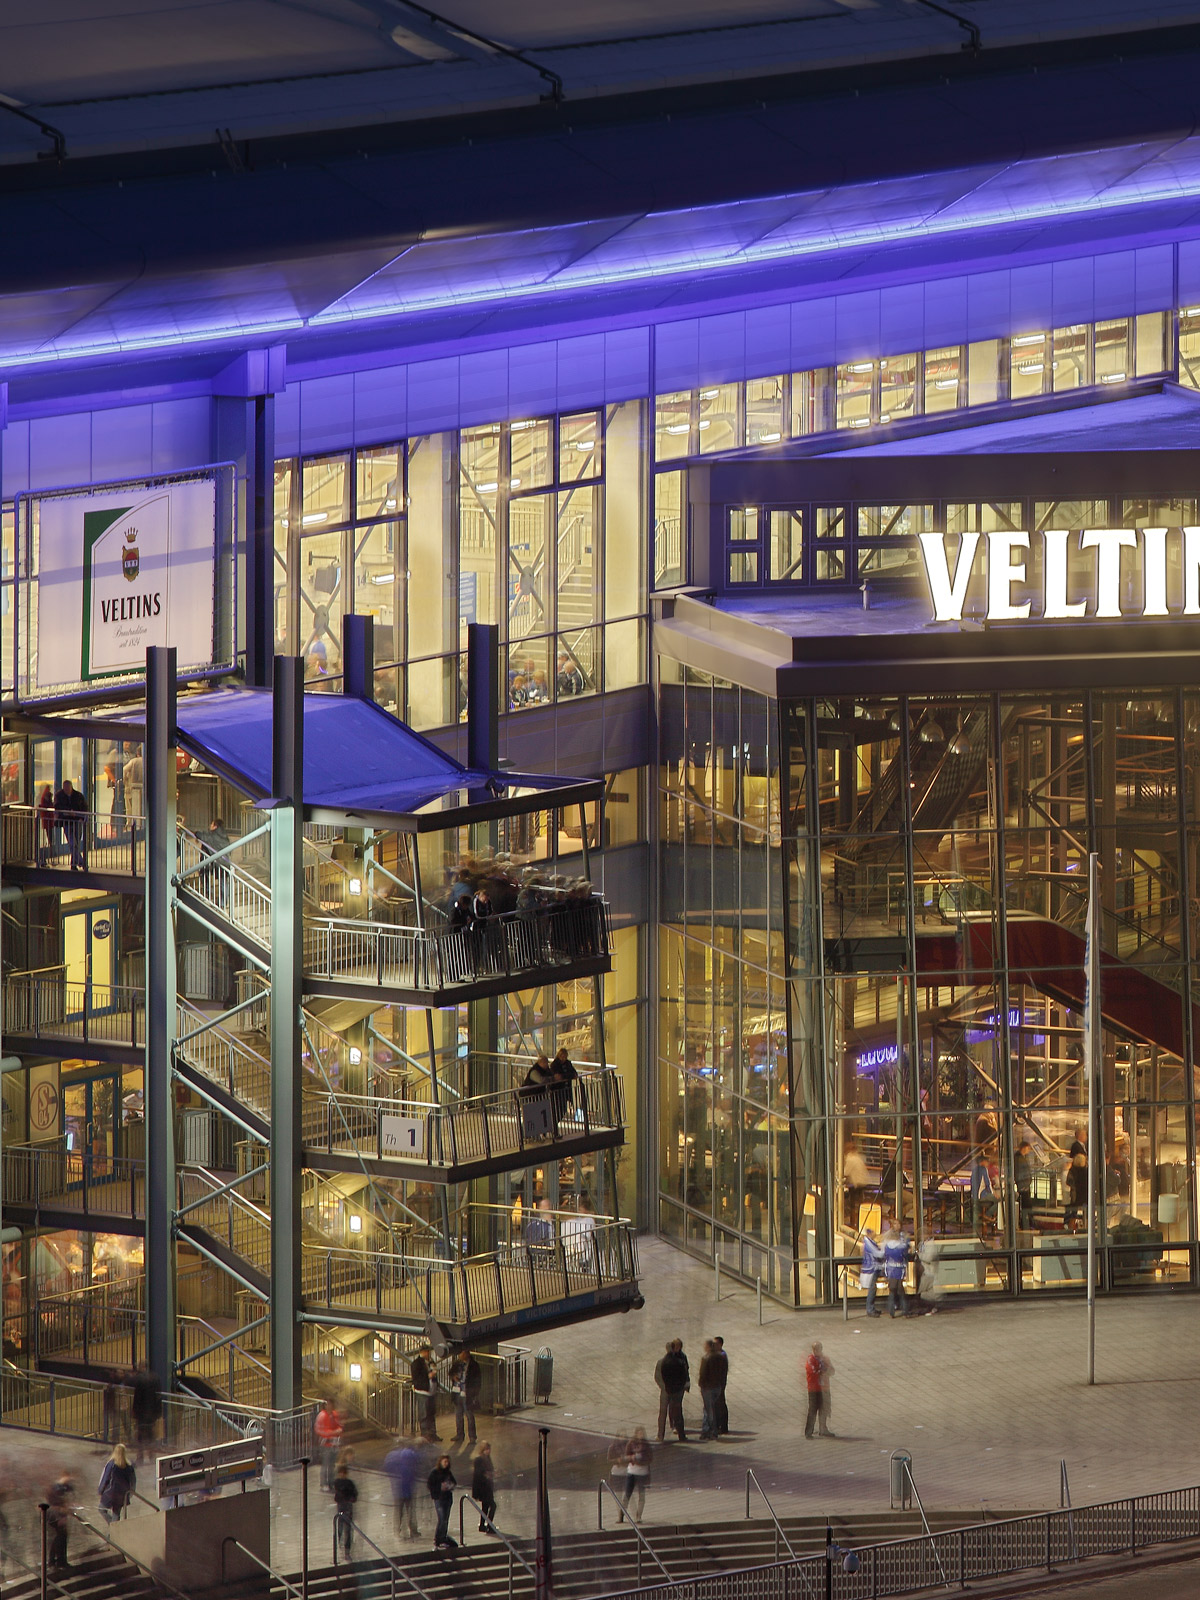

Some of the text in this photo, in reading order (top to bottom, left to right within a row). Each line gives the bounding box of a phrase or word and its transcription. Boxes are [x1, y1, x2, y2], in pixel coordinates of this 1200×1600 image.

[101, 592, 161, 623] VELTINS
[540, 1109, 548, 1128] 1
[385, 1128, 416, 1147] Th 1
[524, 1303, 562, 1319] VICTORIA
